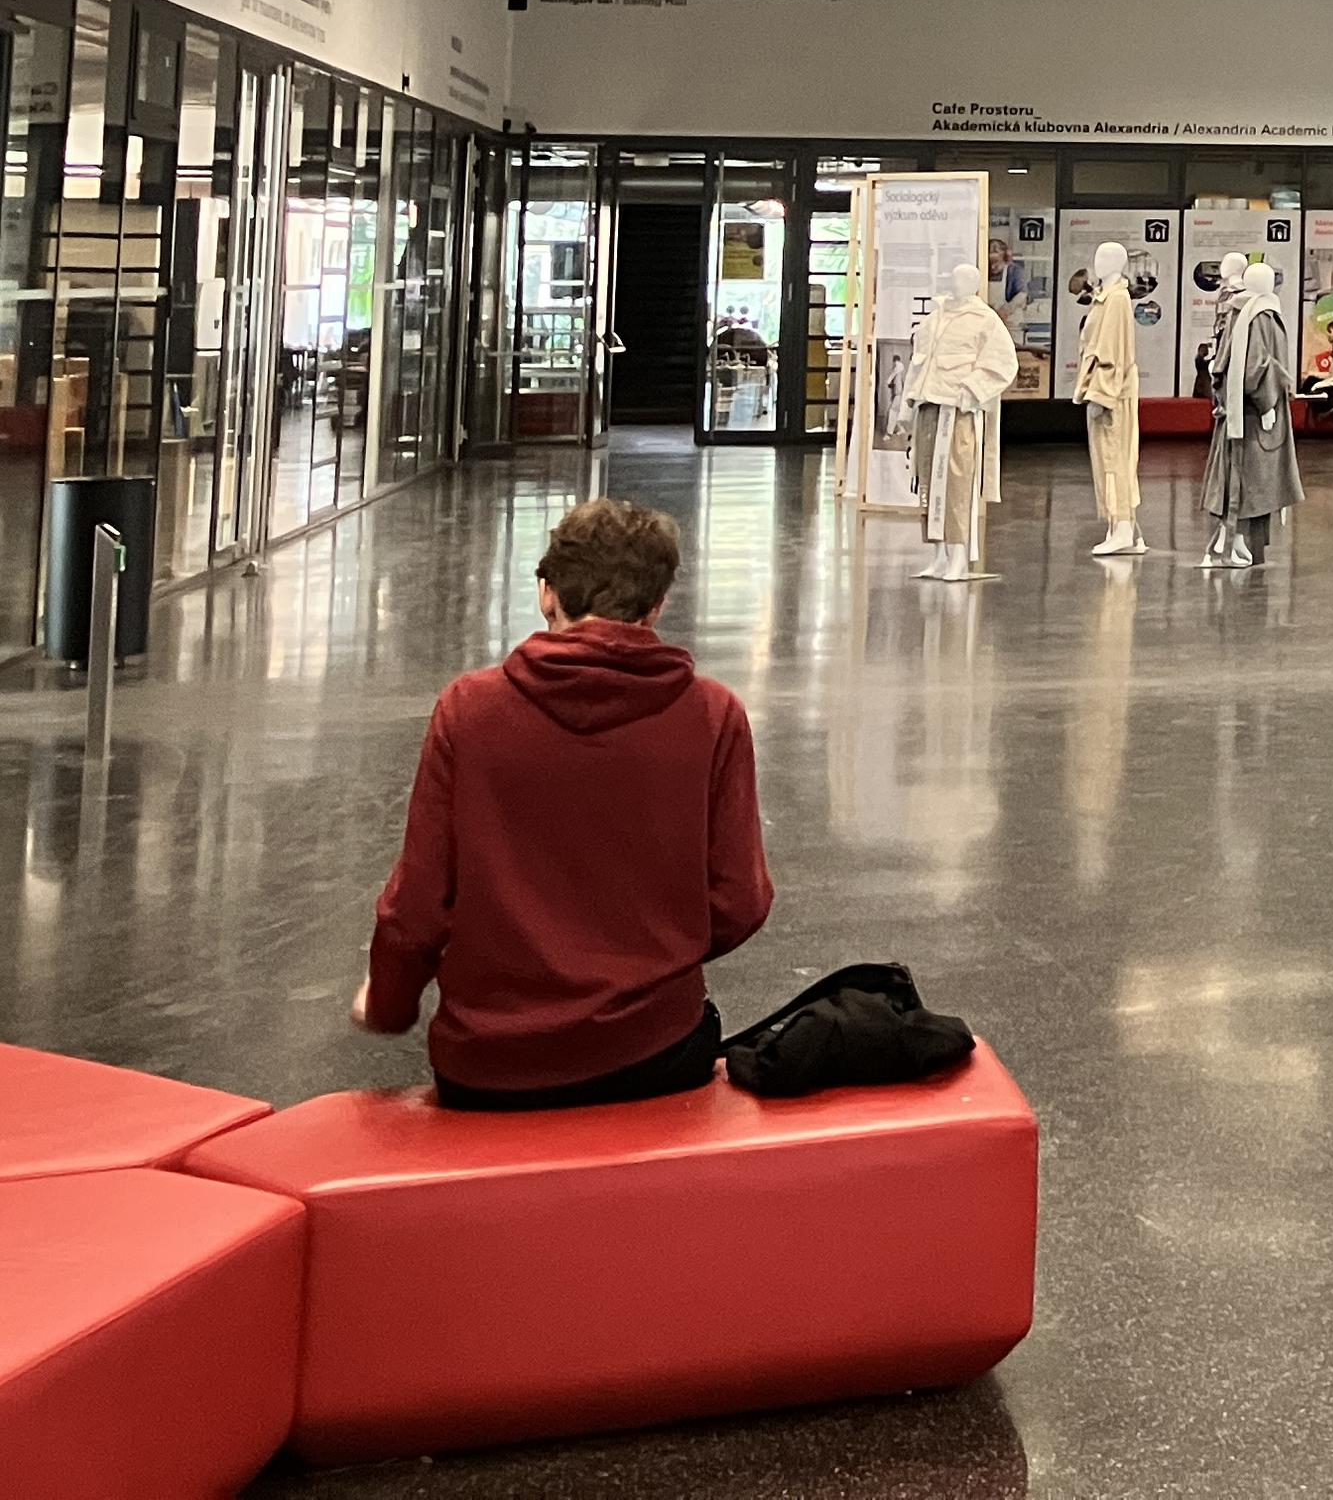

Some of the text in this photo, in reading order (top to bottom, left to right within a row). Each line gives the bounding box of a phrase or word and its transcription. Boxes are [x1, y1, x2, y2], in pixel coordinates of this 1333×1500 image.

[933, 103, 966, 116] Cafe
[933, 118, 1020, 133] Akademická
[1024, 120, 1090, 134] klubovna
[1094, 120, 1169, 135] Alexandria
[1183, 122, 1257, 136] Alexandria
[1261, 124, 1327, 138] Academic
